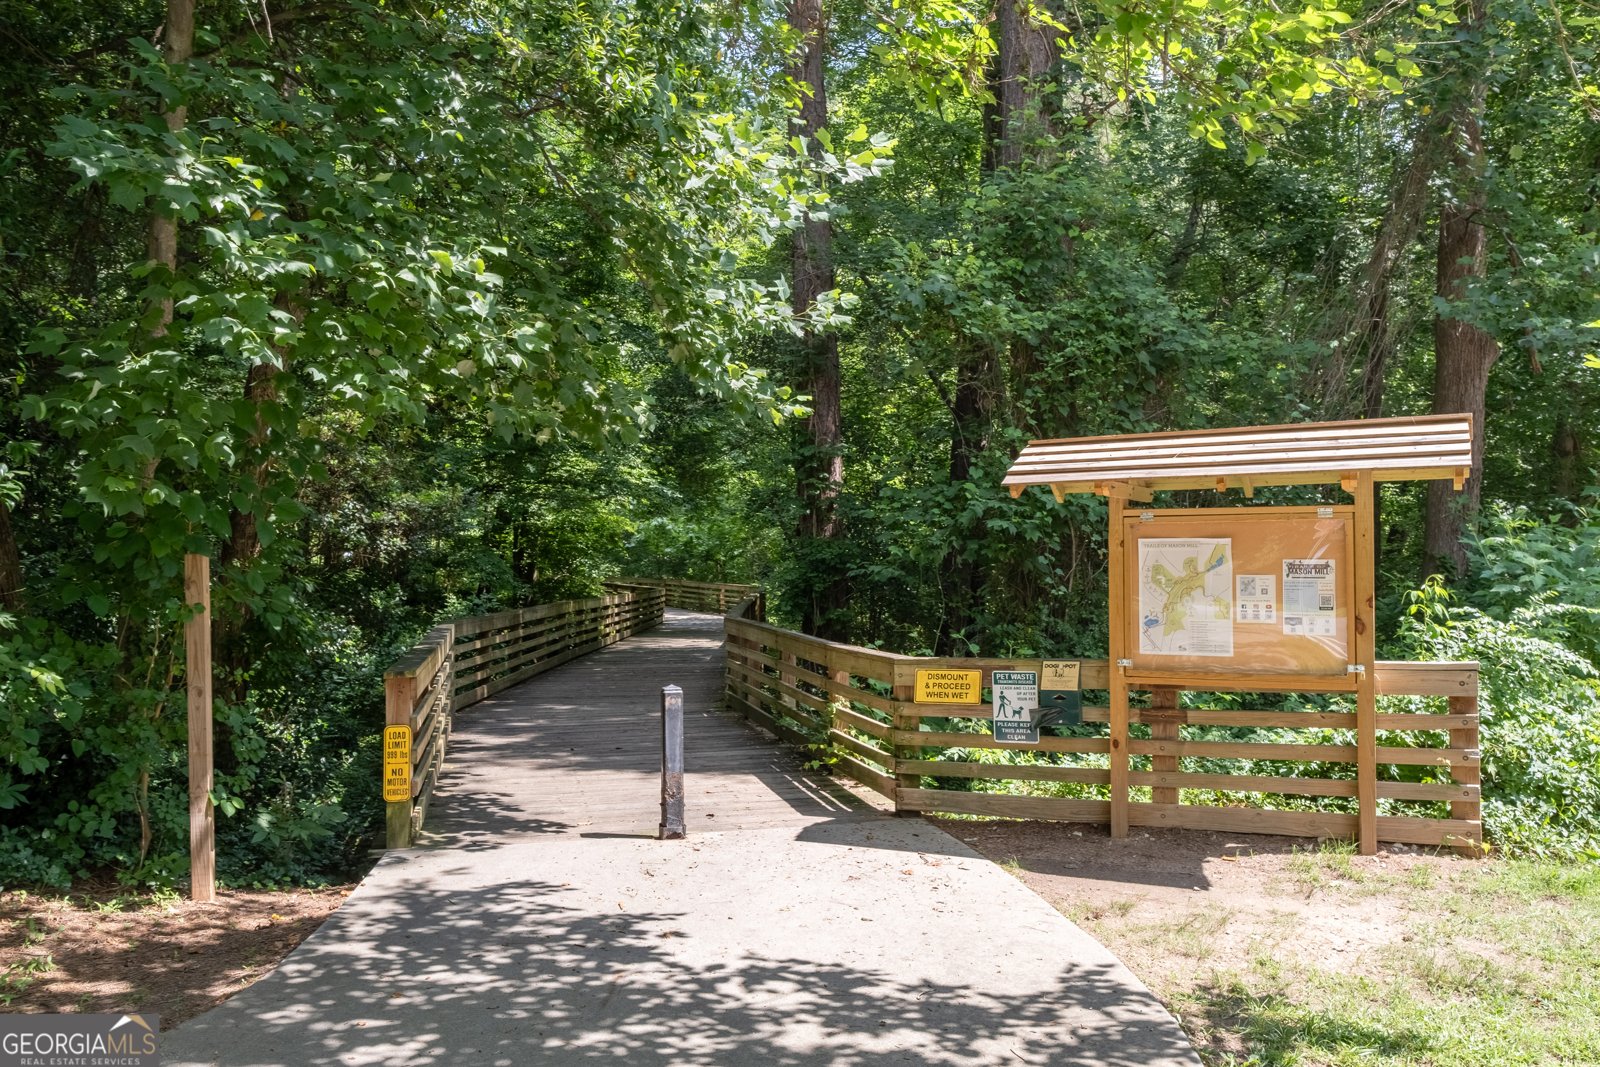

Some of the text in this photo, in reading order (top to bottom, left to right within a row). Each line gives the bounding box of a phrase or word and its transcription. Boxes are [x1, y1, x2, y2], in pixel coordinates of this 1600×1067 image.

[388, 741, 406, 749] LIMIT
[387, 751, 408, 759] 999 lbs
[392, 768, 403, 776] NO
[387, 778, 407, 786] MOTOR
